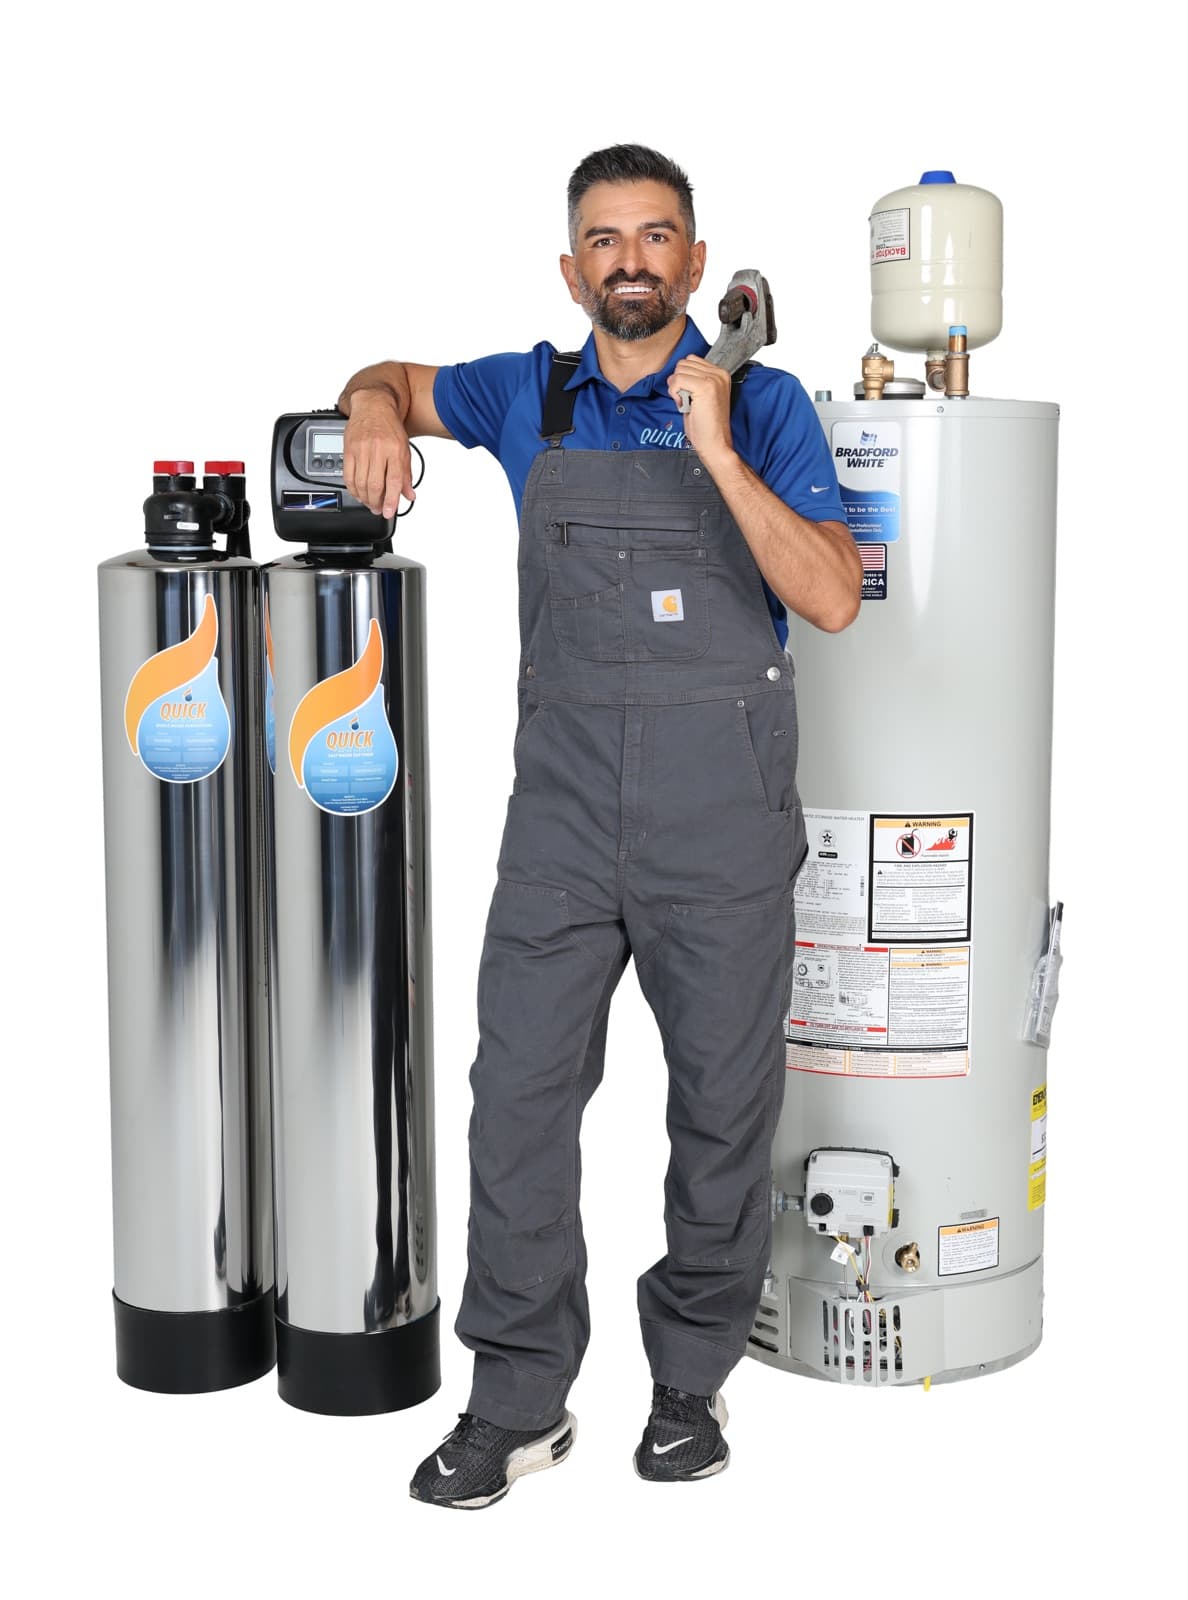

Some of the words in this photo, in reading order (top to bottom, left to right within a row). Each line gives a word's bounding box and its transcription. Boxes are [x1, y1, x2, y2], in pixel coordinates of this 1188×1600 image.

[640, 428, 687, 449] QUICK
[835, 447, 899, 458] BRADFORD
[847, 458, 885, 468] WHITE
[862, 578, 885, 586] RICA
[159, 702, 208, 721] QUICK
[326, 730, 374, 750] QUICK
